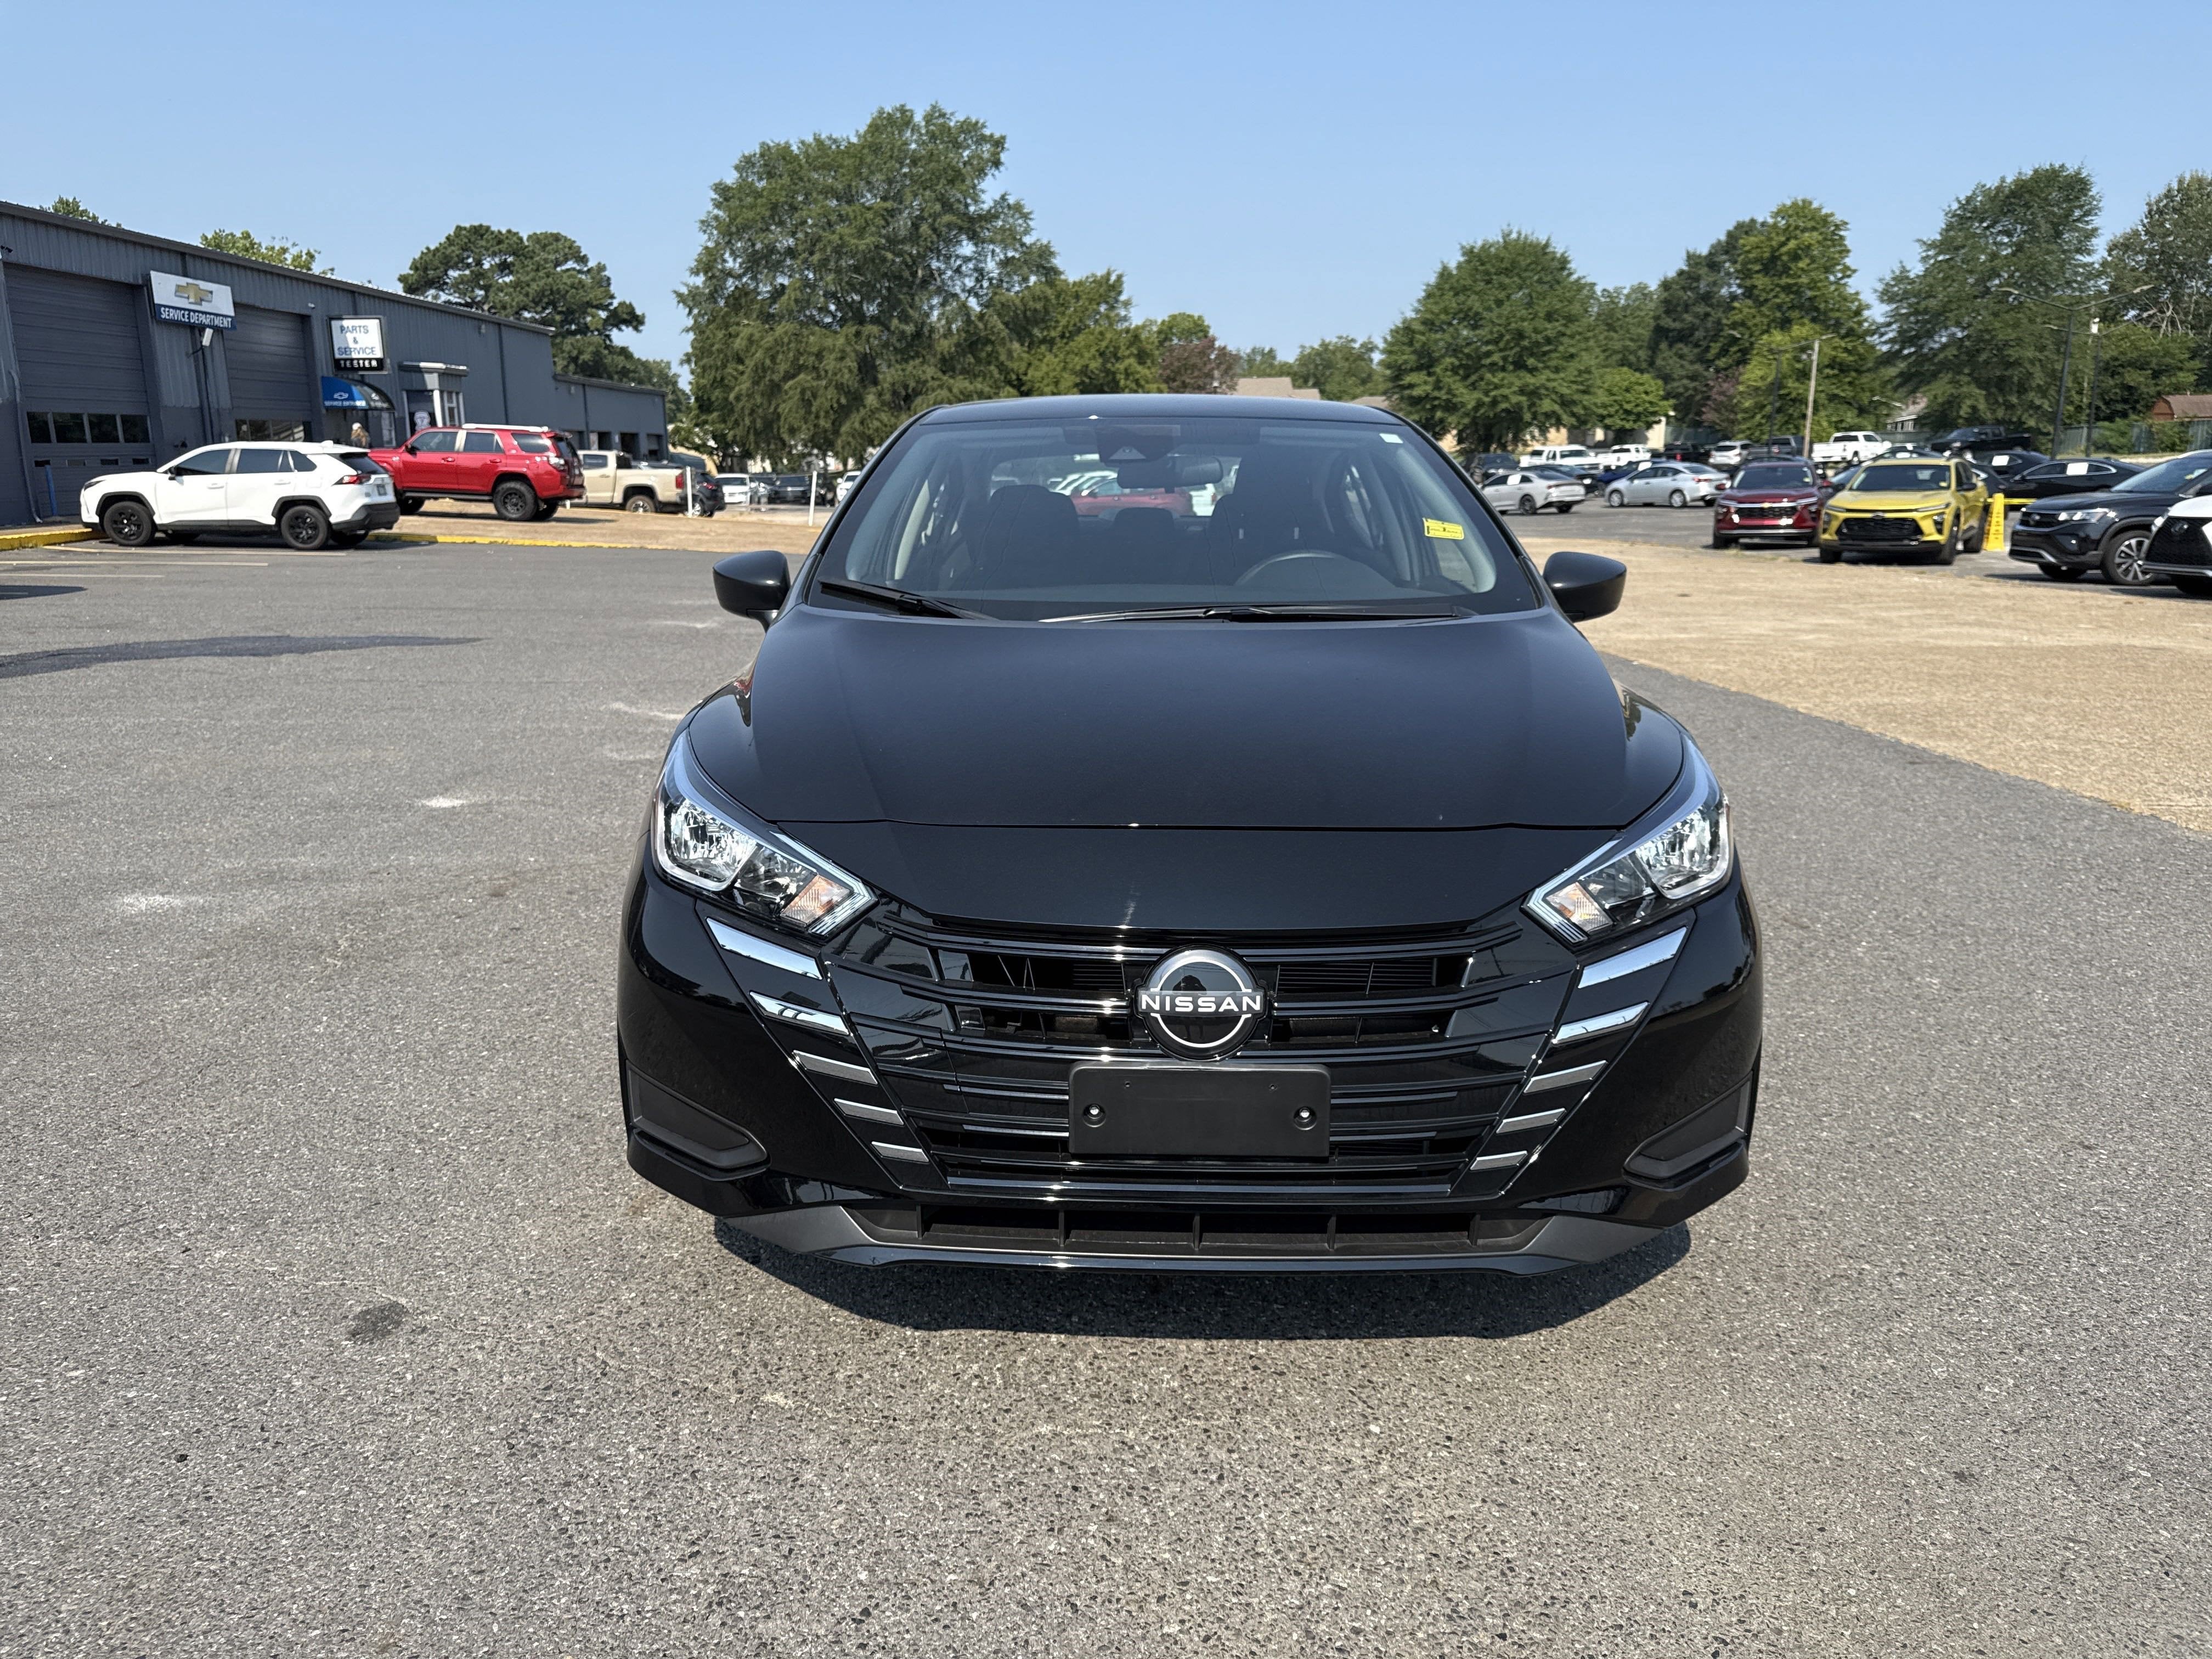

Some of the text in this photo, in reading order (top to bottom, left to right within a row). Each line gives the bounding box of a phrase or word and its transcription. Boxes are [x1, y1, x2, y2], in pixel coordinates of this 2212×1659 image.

[161, 307, 232, 328] SERVICE DEPARTMENT
[340, 325, 369, 334] PARTS
[353, 336, 358, 345] &
[337, 347, 377, 356] SERVICE
[340, 359, 377, 368] TESTER
[1141, 994, 1261, 1012] NISSAN
